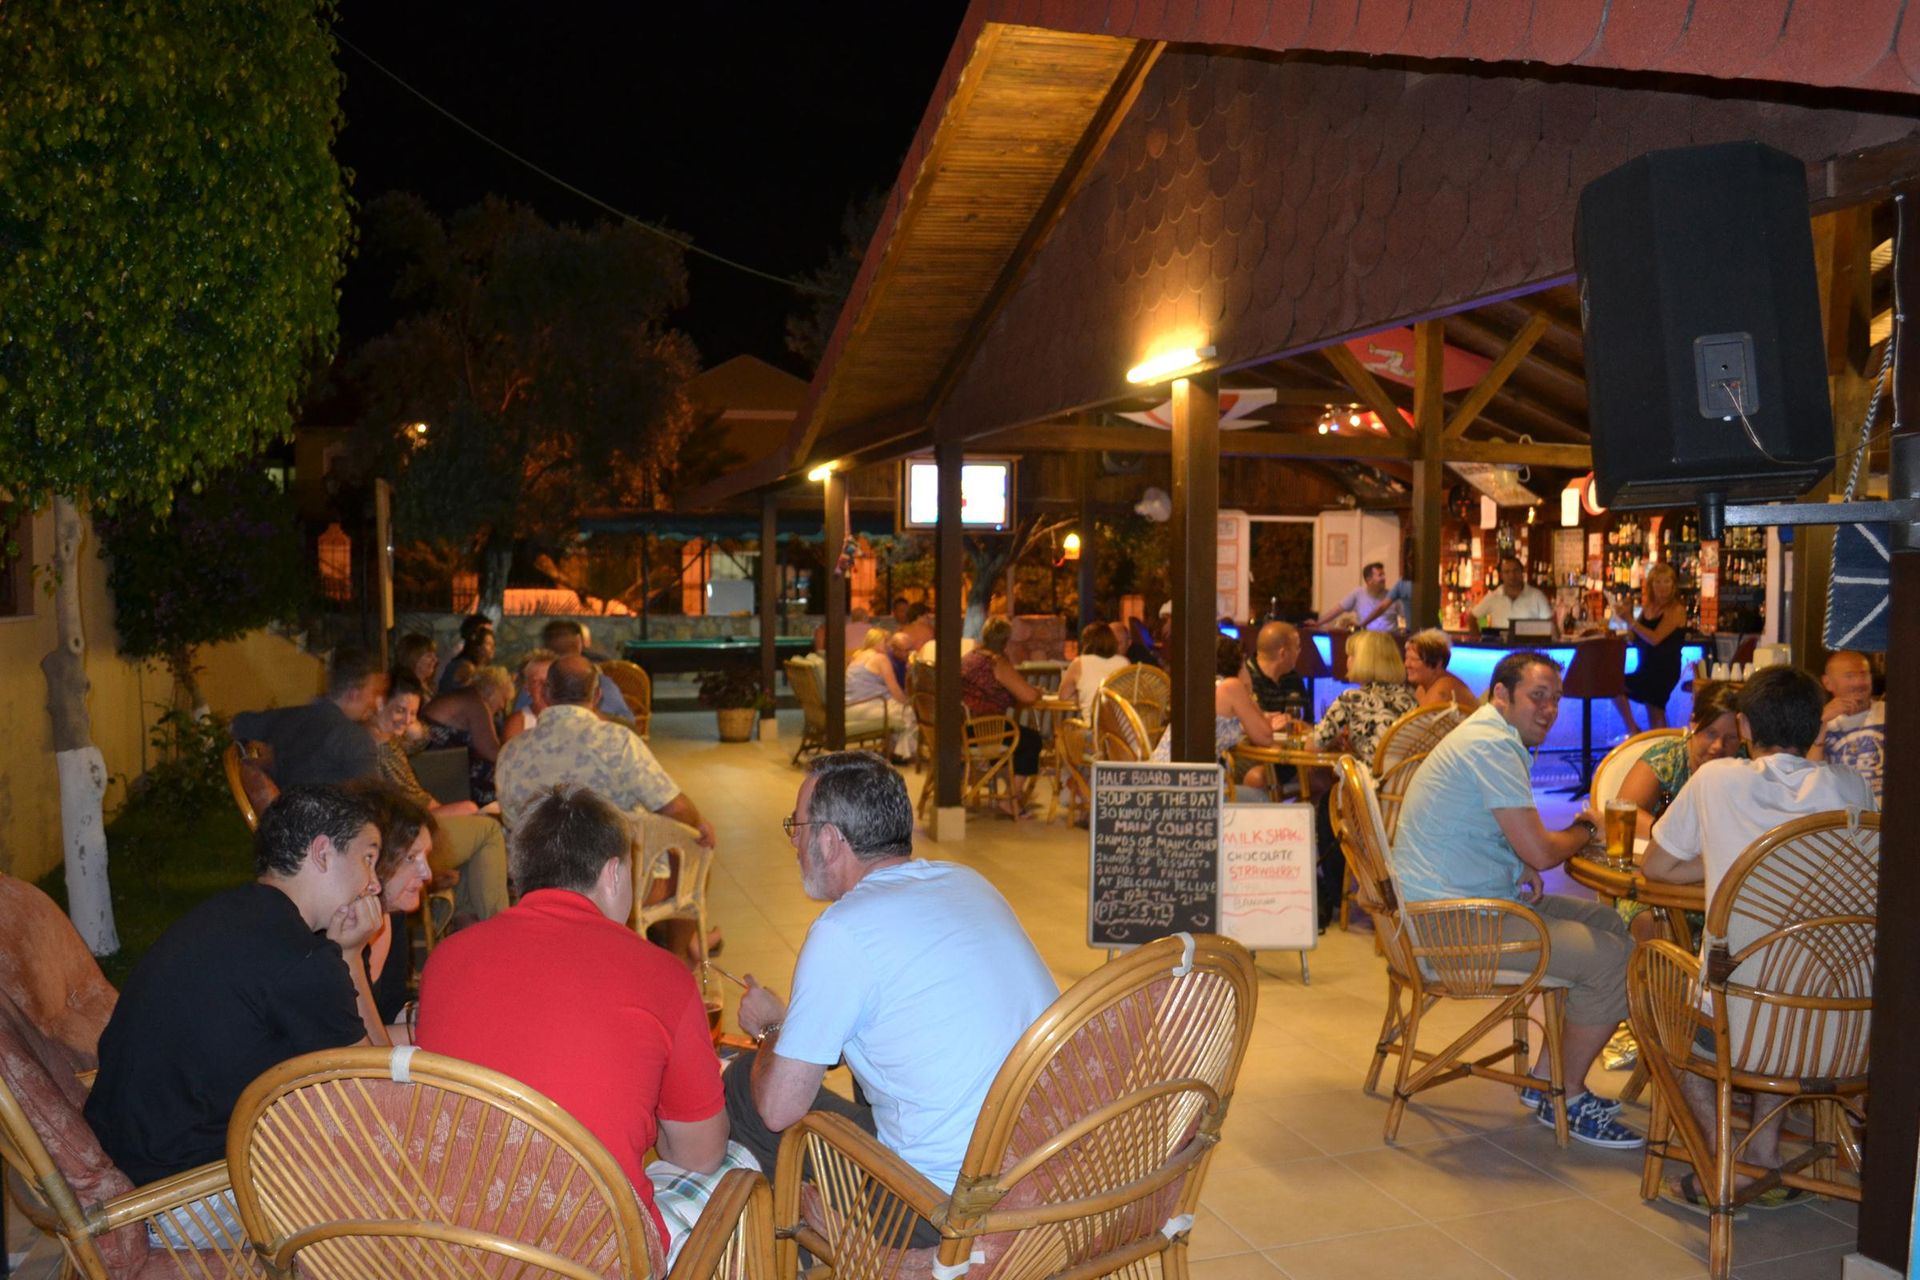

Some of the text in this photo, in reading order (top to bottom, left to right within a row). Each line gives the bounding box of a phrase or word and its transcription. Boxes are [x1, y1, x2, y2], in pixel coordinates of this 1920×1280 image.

[1098, 770, 1219, 786] HALF BOARD MENU
[1098, 791, 1216, 806] SOUP OF THE DAY
[1099, 807, 1117, 820] 30
[1143, 808, 1160, 821] OF
[1114, 820, 1214, 837] MAIN COURSE
[1137, 836, 1153, 848] OF
[1223, 829, 1263, 845] MILK
[1136, 856, 1150, 866] OF
[1227, 849, 1293, 862] CHOCOLATE
[1138, 866, 1152, 877] OF
[1160, 868, 1200, 880] FRUITS
[1098, 876, 1114, 887] AT
[1174, 879, 1218, 893] DELUXE
[1101, 890, 1119, 901] AT
[1151, 891, 1178, 902] TILL
